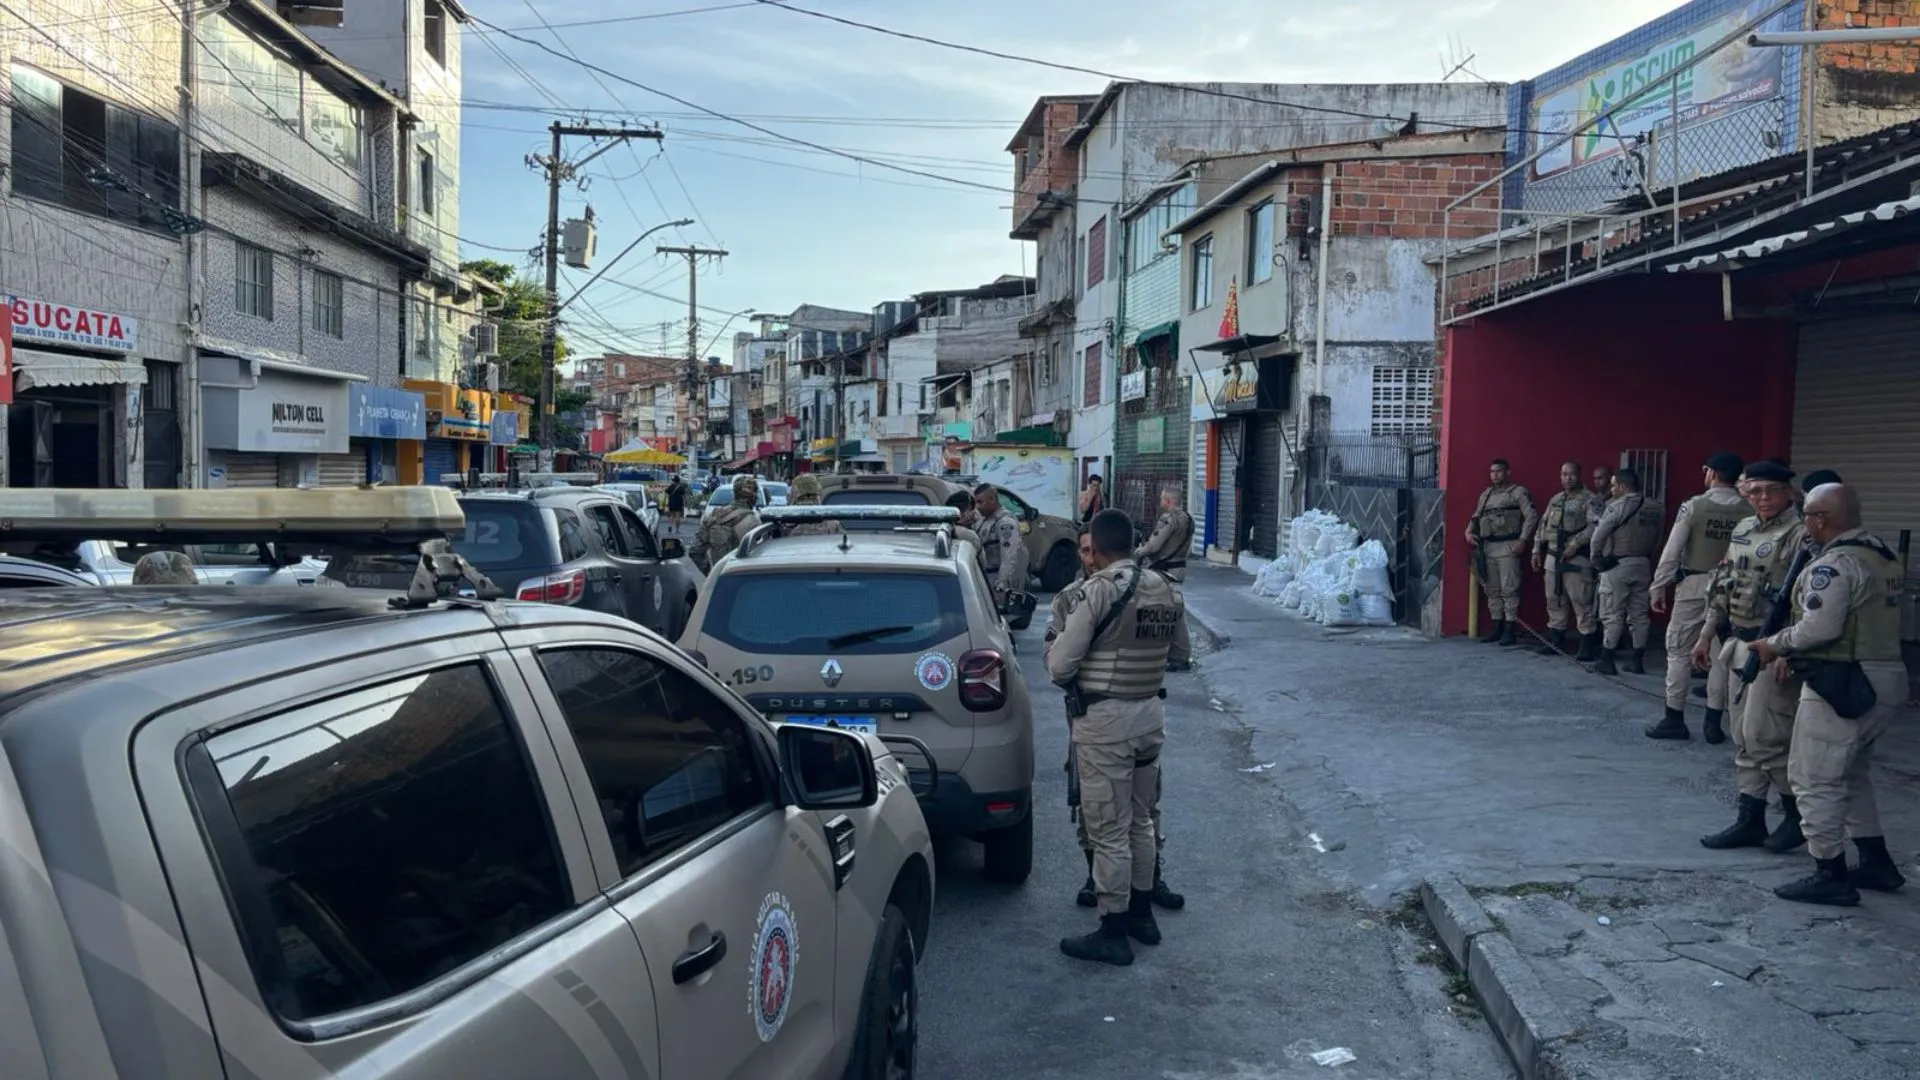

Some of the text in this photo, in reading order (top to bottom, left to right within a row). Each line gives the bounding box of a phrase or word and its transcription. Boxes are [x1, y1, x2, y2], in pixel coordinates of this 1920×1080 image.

[12, 299, 124, 340] SUCATA
[272, 403, 324, 425] NILTON CELL
[1706, 518, 1737, 530] POLÍC
[1705, 529, 1732, 541] MILIT
[356, 573, 382, 587] 190
[732, 664, 774, 685] 190
[769, 699, 893, 708] DUSTER
